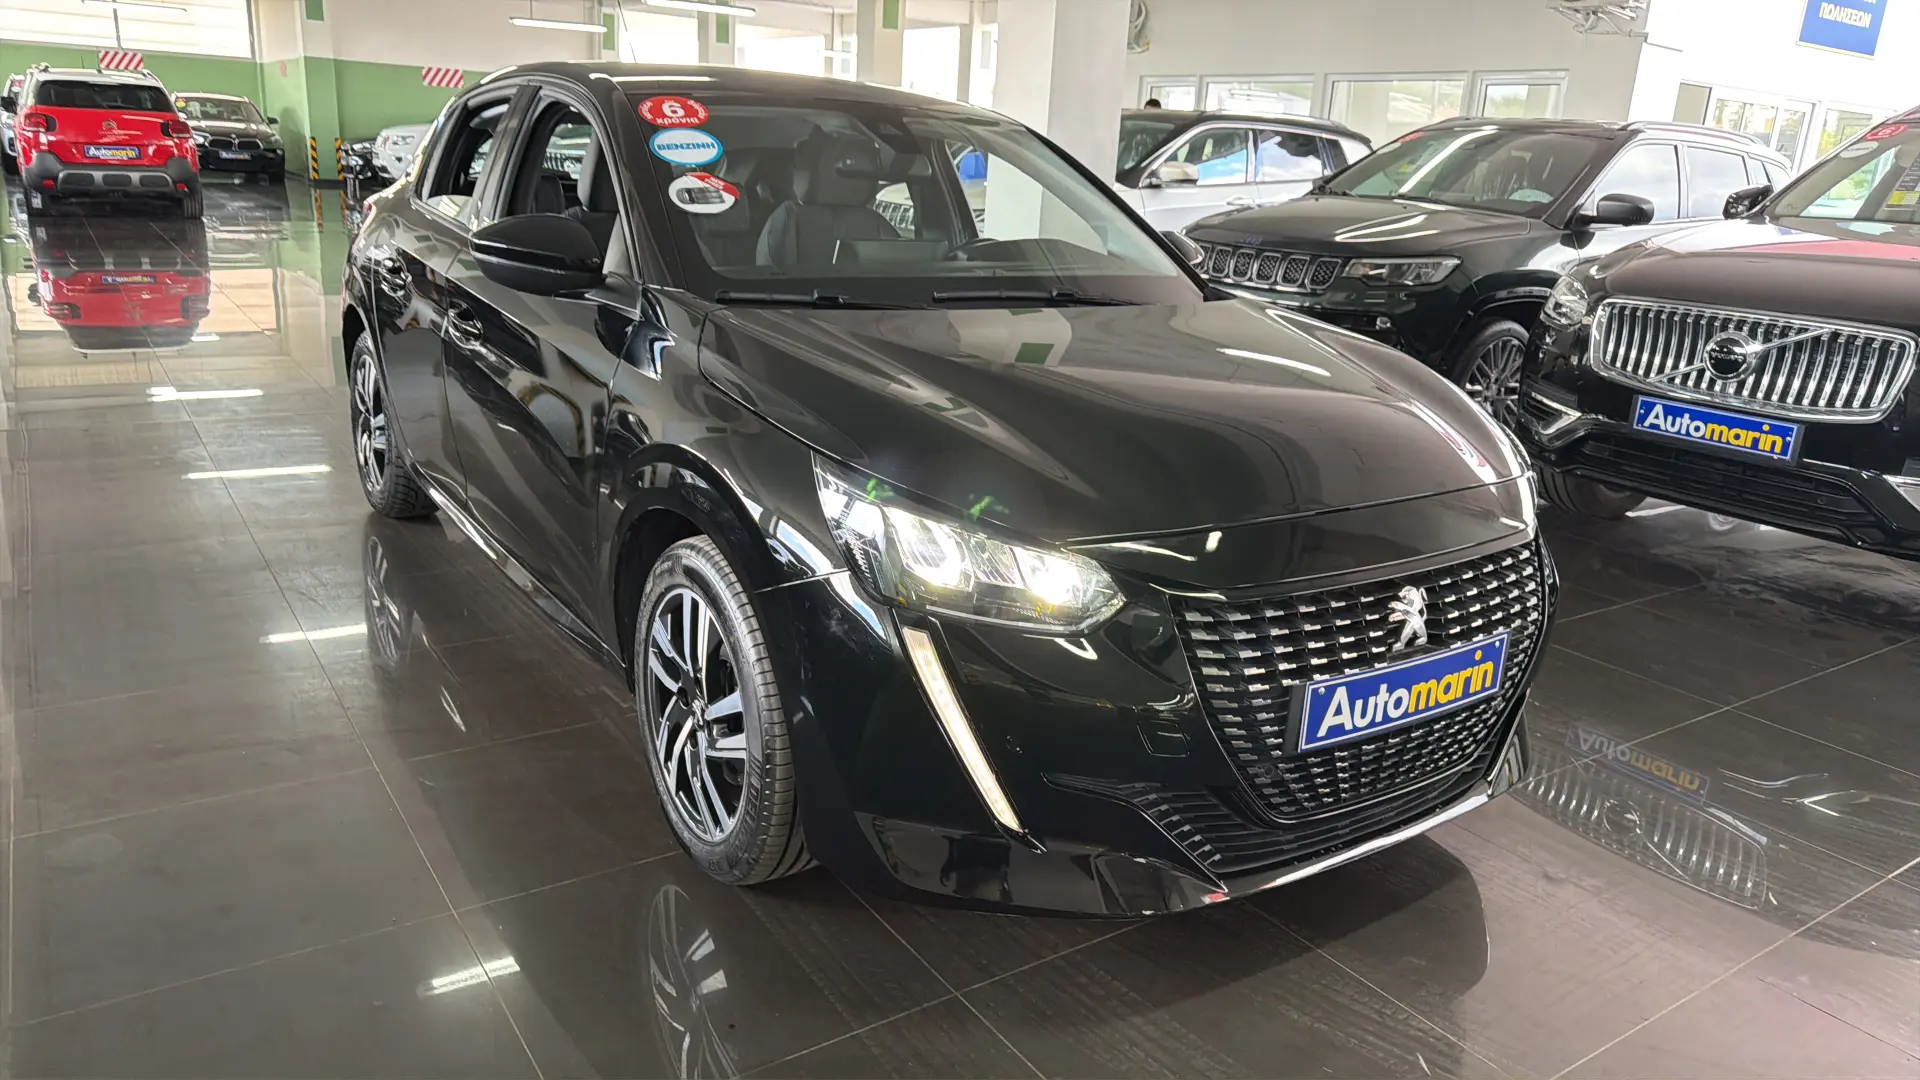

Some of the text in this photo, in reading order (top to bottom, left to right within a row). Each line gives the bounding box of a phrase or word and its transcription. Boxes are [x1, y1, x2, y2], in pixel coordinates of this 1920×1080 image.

[662, 102, 685, 117] 6
[1643, 404, 1783, 454] Automarin
[1317, 650, 1494, 737] Automarin
